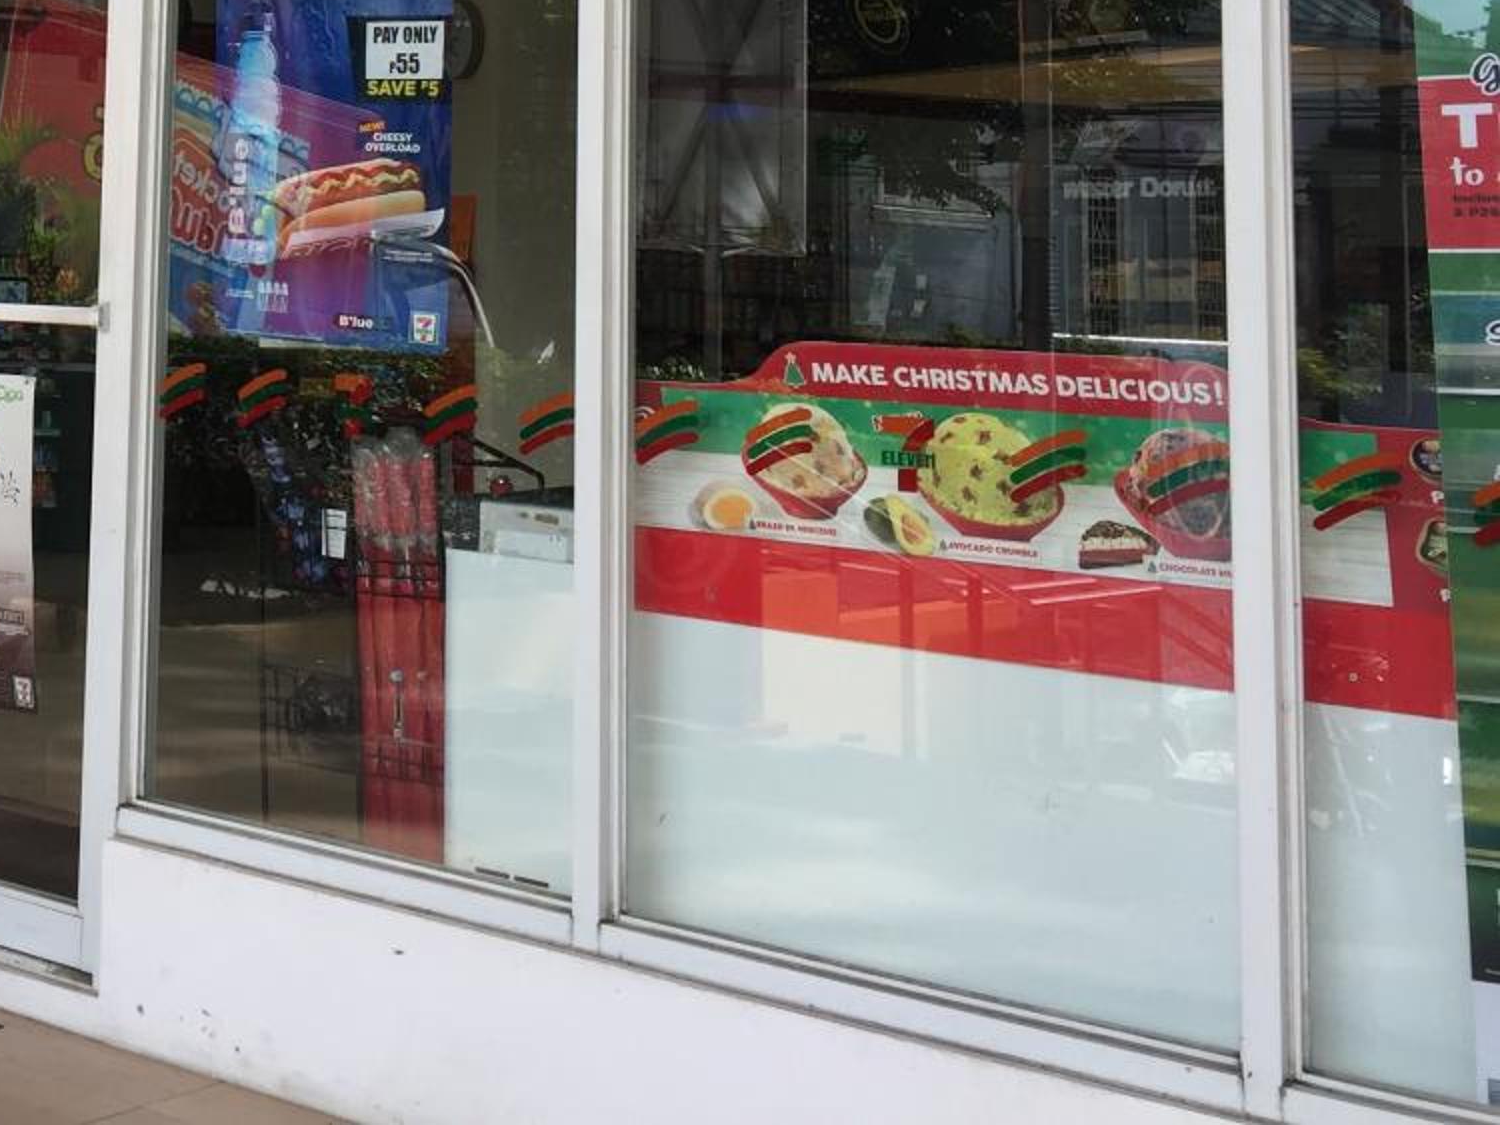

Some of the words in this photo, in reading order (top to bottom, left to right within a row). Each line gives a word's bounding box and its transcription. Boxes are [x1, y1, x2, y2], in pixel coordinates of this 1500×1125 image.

[372, 26, 400, 44] PAY
[403, 24, 439, 44] ONLY
[366, 79, 417, 97] SAVE
[364, 142, 421, 154] OVERLOAD
[1449, 155, 1485, 187] to
[811, 362, 885, 386] MAKE
[892, 366, 1049, 396] CHRISTMAS
[1055, 376, 1224, 407] DELICIOUS!
